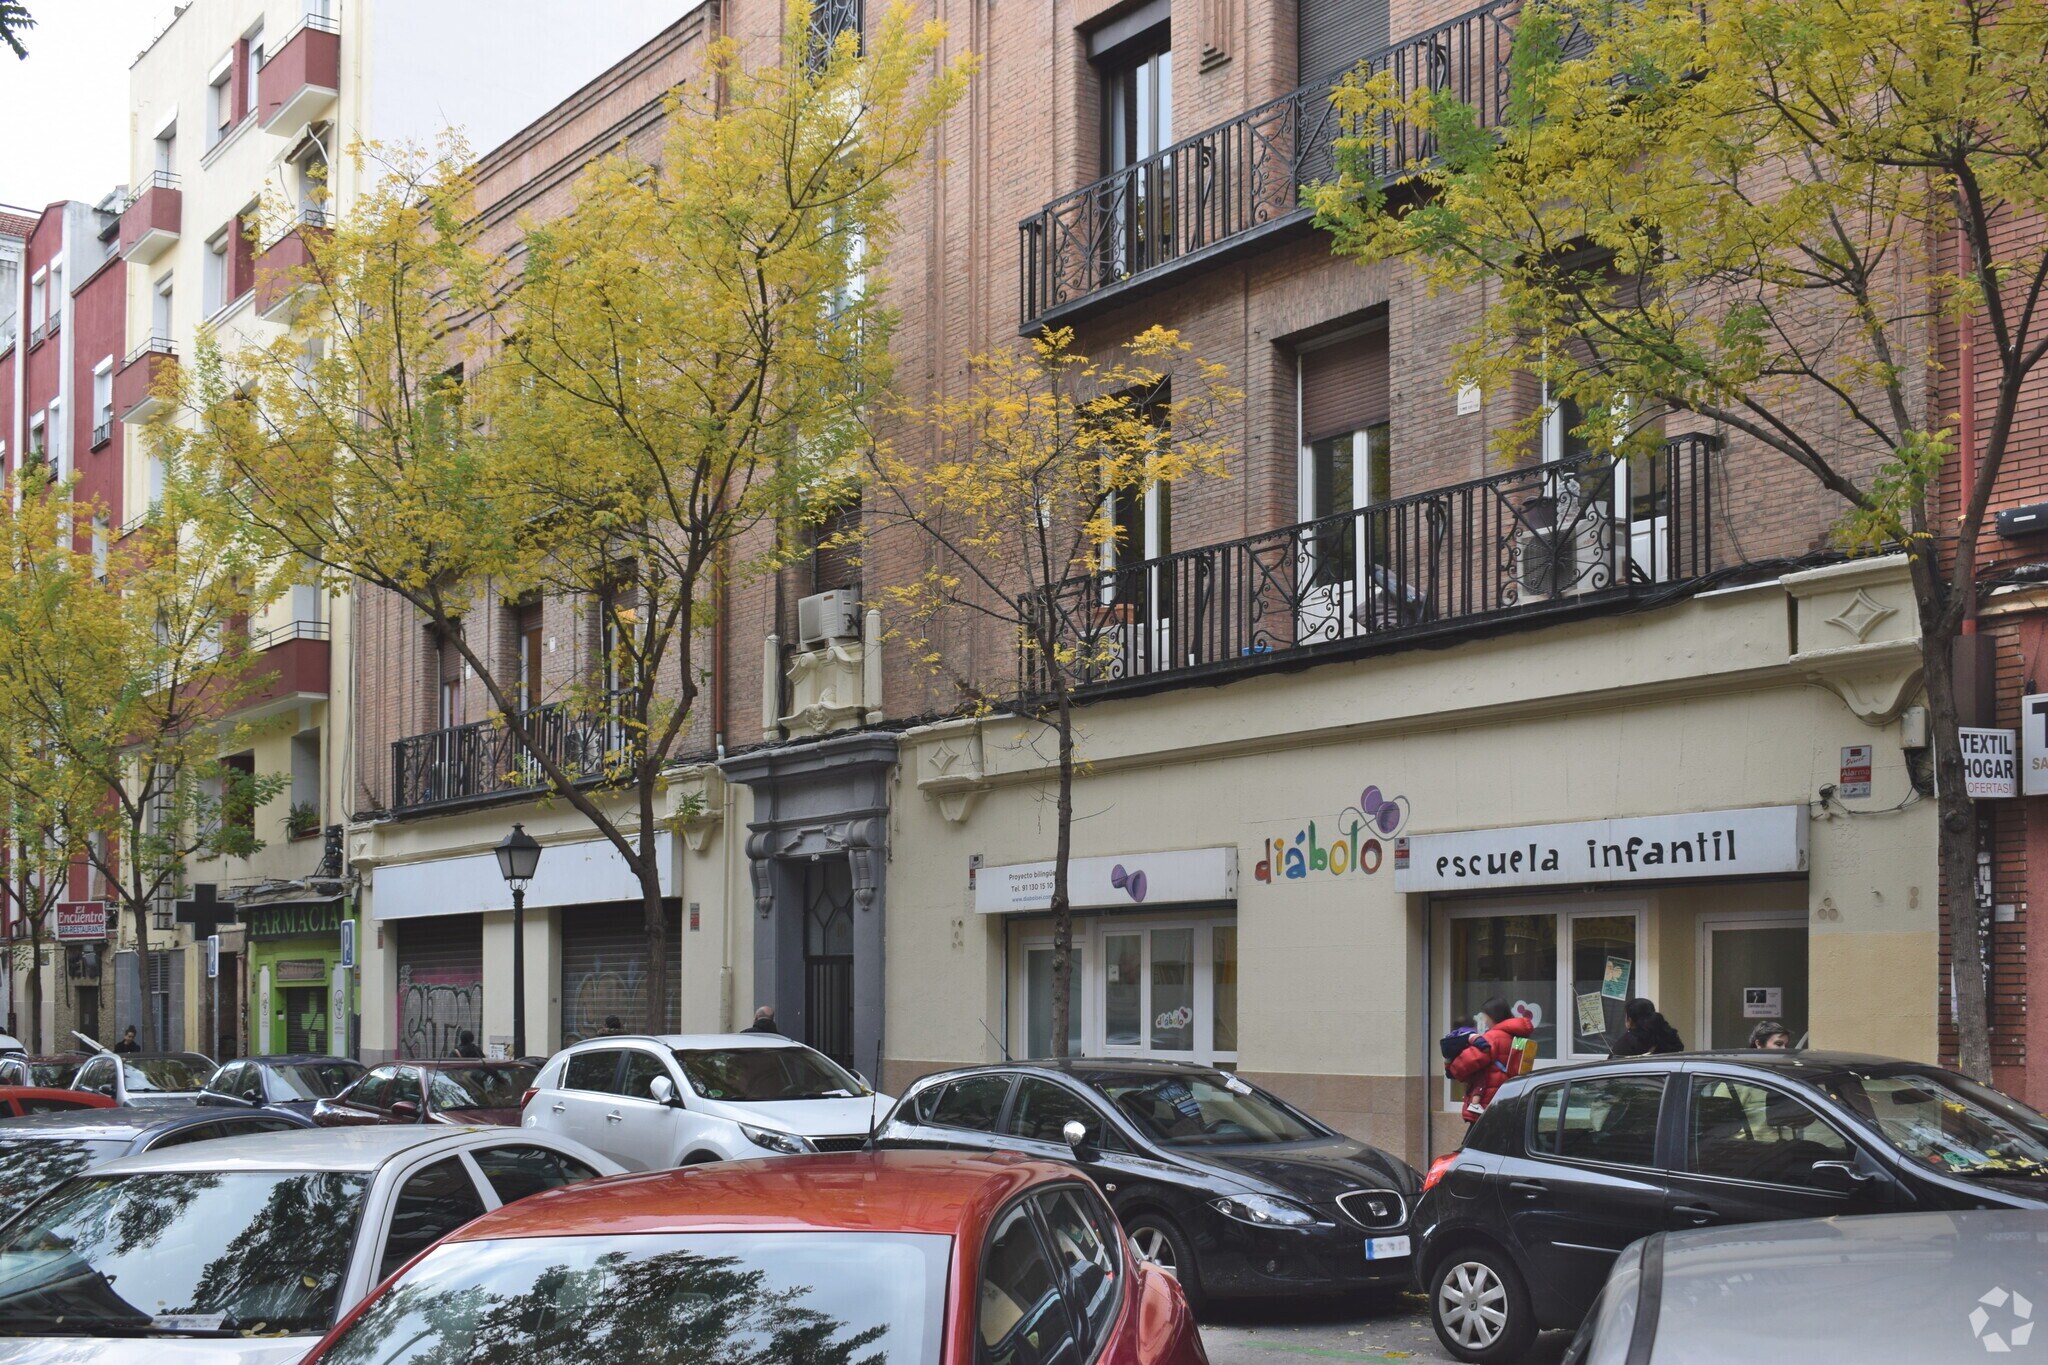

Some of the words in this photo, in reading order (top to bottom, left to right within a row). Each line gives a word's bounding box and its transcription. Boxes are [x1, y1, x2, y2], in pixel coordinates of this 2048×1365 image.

[1960, 733, 2013, 755] TEXTIL
[1964, 758, 2014, 779] HOGAR
[1254, 819, 1383, 884] diábolo
[1436, 843, 1559, 877] escuela
[1586, 830, 1736, 872] infantil
[1009, 871, 1033, 881] Proyecto
[1047, 881, 1054, 889] 10
[58, 911, 104, 924] Encuentro
[251, 903, 341, 936] FARMACIA
